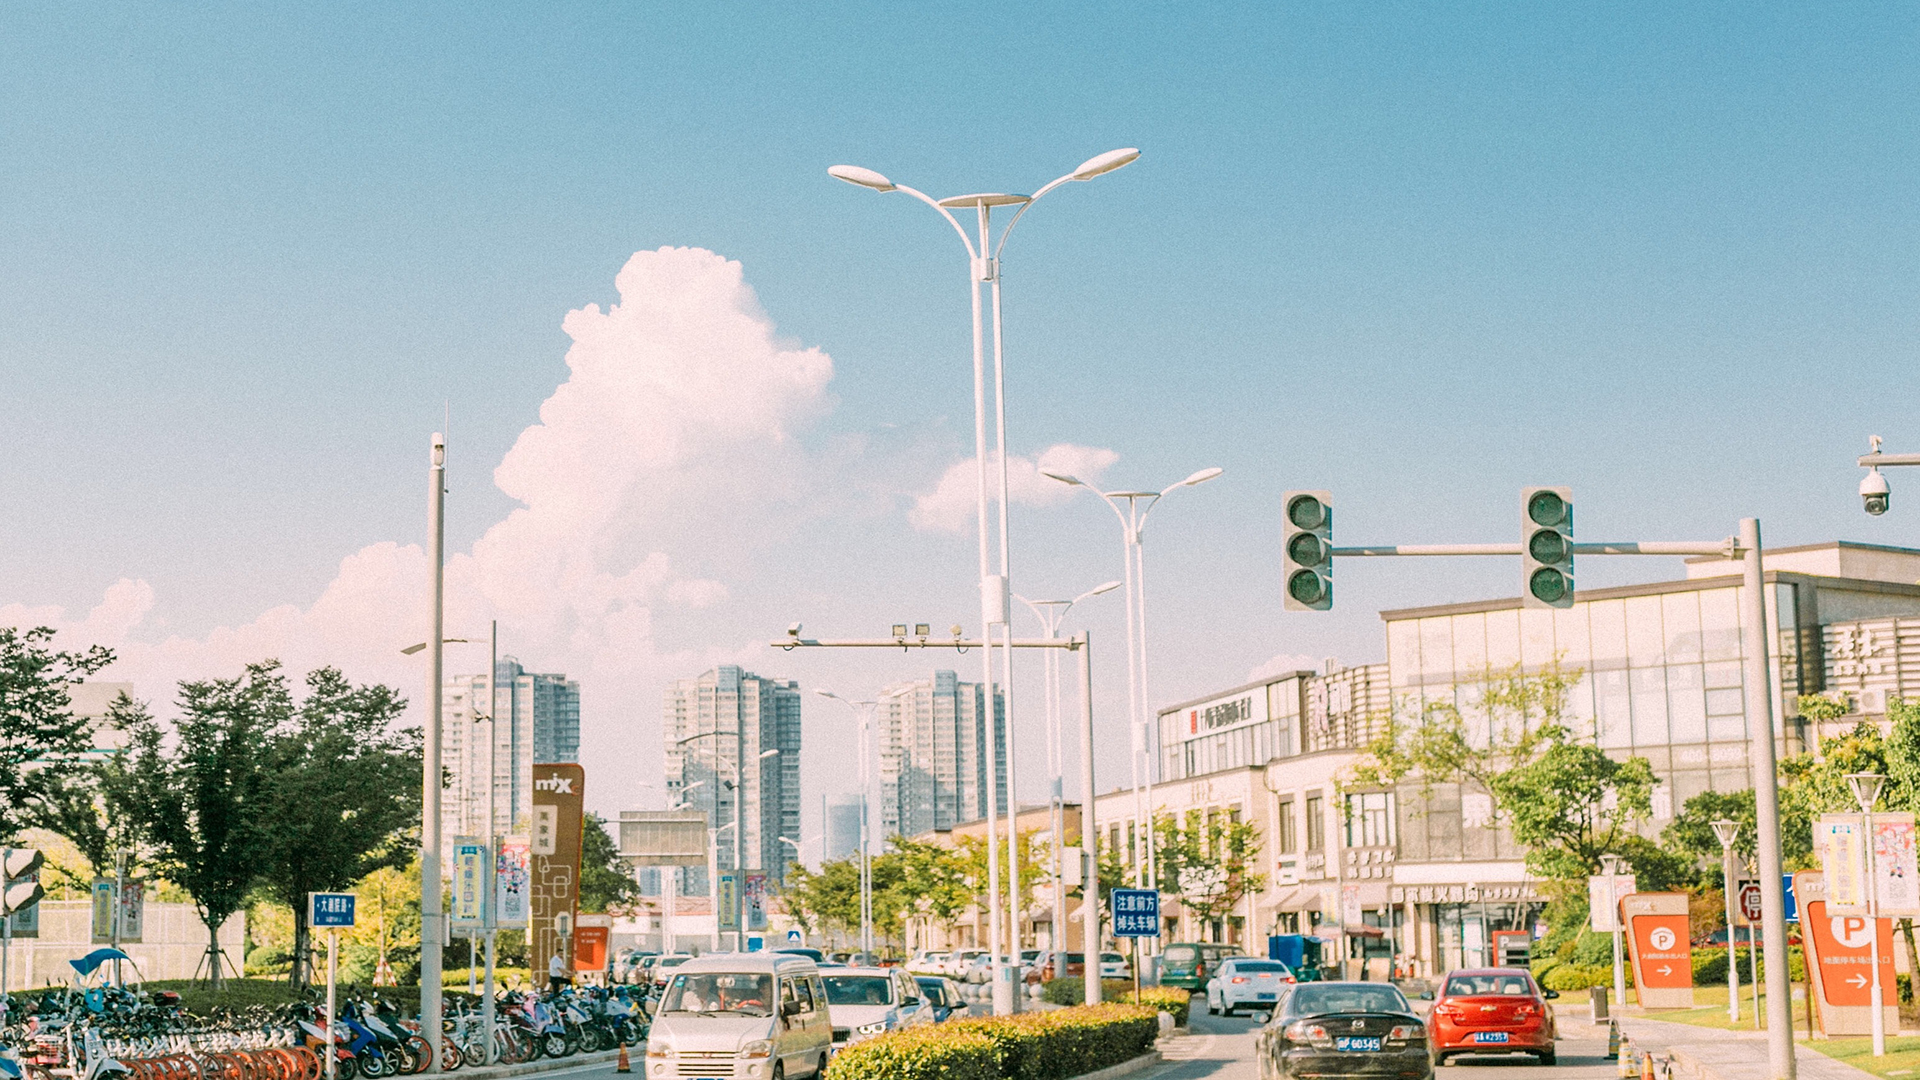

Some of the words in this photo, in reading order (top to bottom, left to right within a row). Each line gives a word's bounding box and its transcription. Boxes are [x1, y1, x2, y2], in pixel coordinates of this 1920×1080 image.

[1117, 895, 1155, 911] 注意前方
[1744, 889, 1761, 919] 停
[1117, 914, 1156, 931] 掉头车辆
[1843, 917, 1866, 940] P
[1500, 936, 1509, 948] P
[1659, 935, 1668, 948] P
